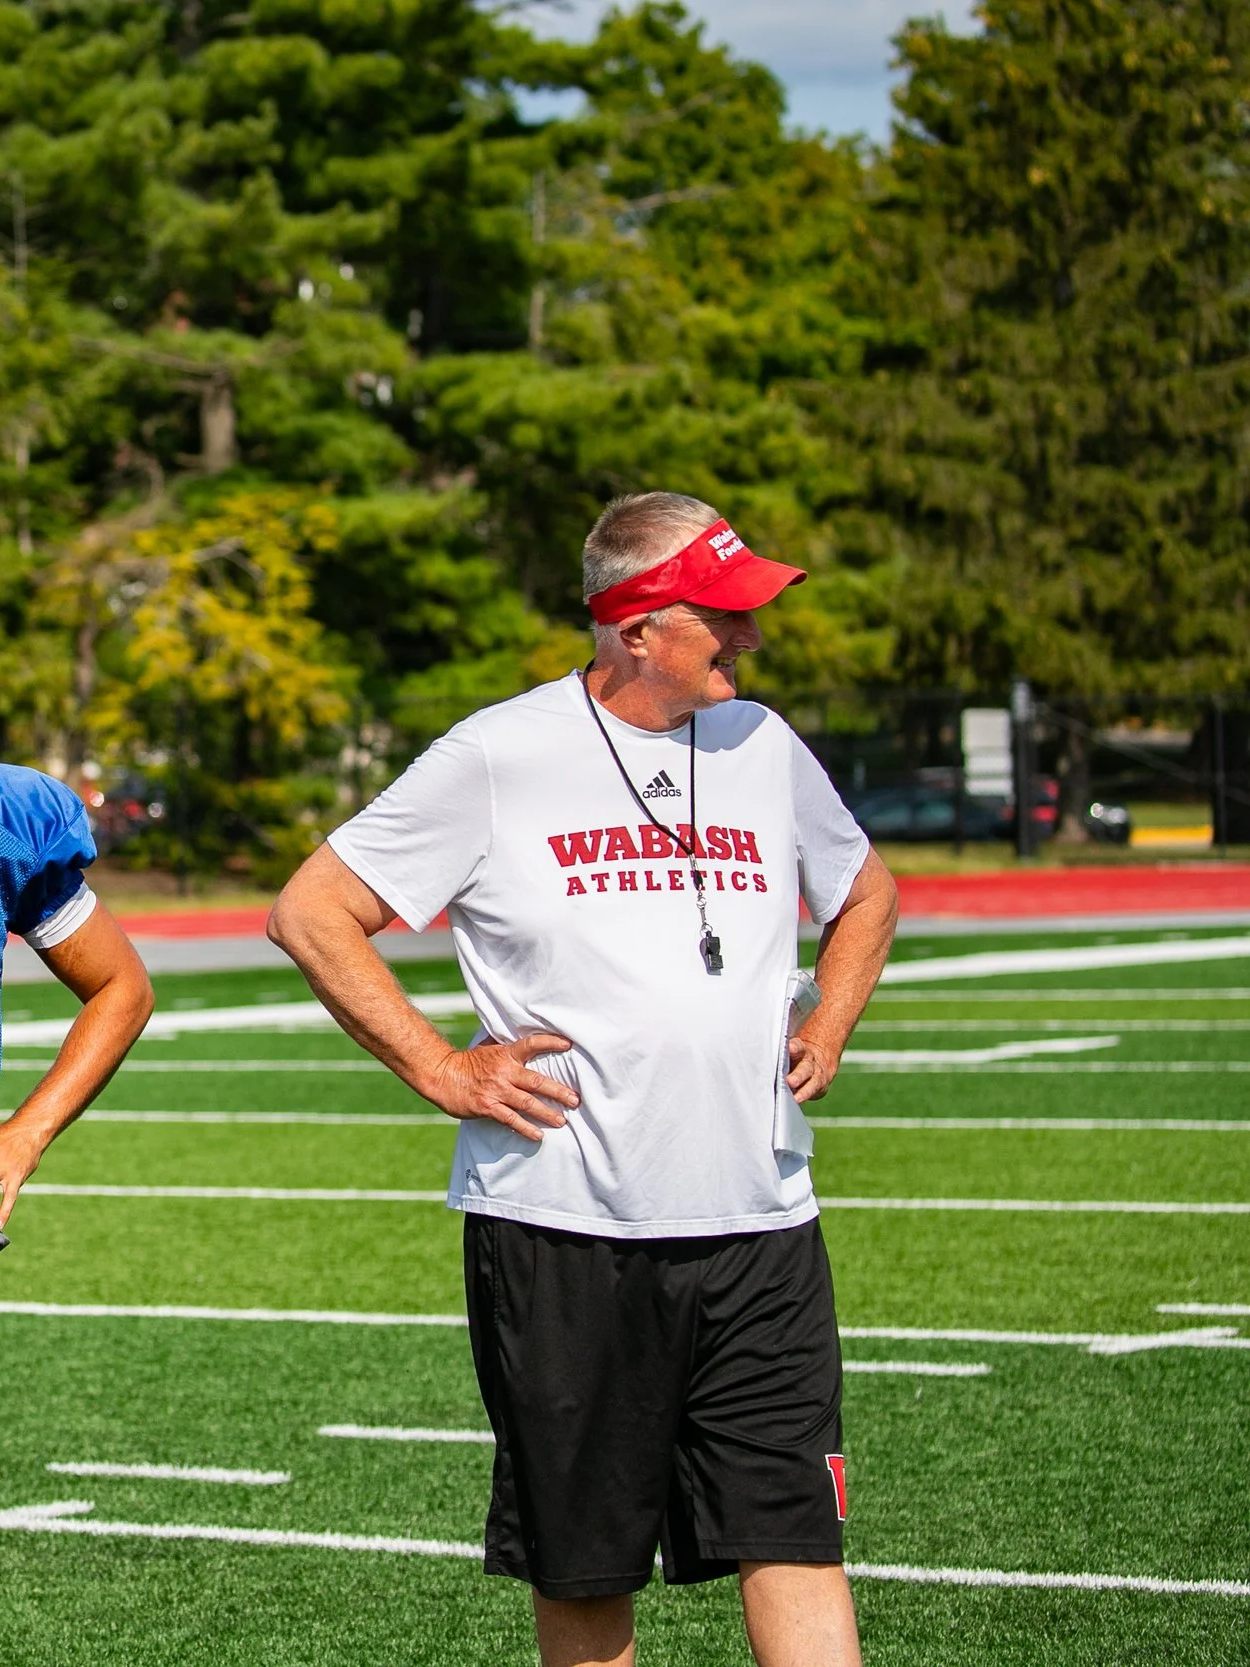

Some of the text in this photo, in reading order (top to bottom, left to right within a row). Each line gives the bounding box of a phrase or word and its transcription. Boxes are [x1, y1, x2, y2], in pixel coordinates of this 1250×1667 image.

[642, 787, 682, 799] adidas
[548, 823, 763, 867] WABASH
[567, 870, 768, 896] ATHLETICS
